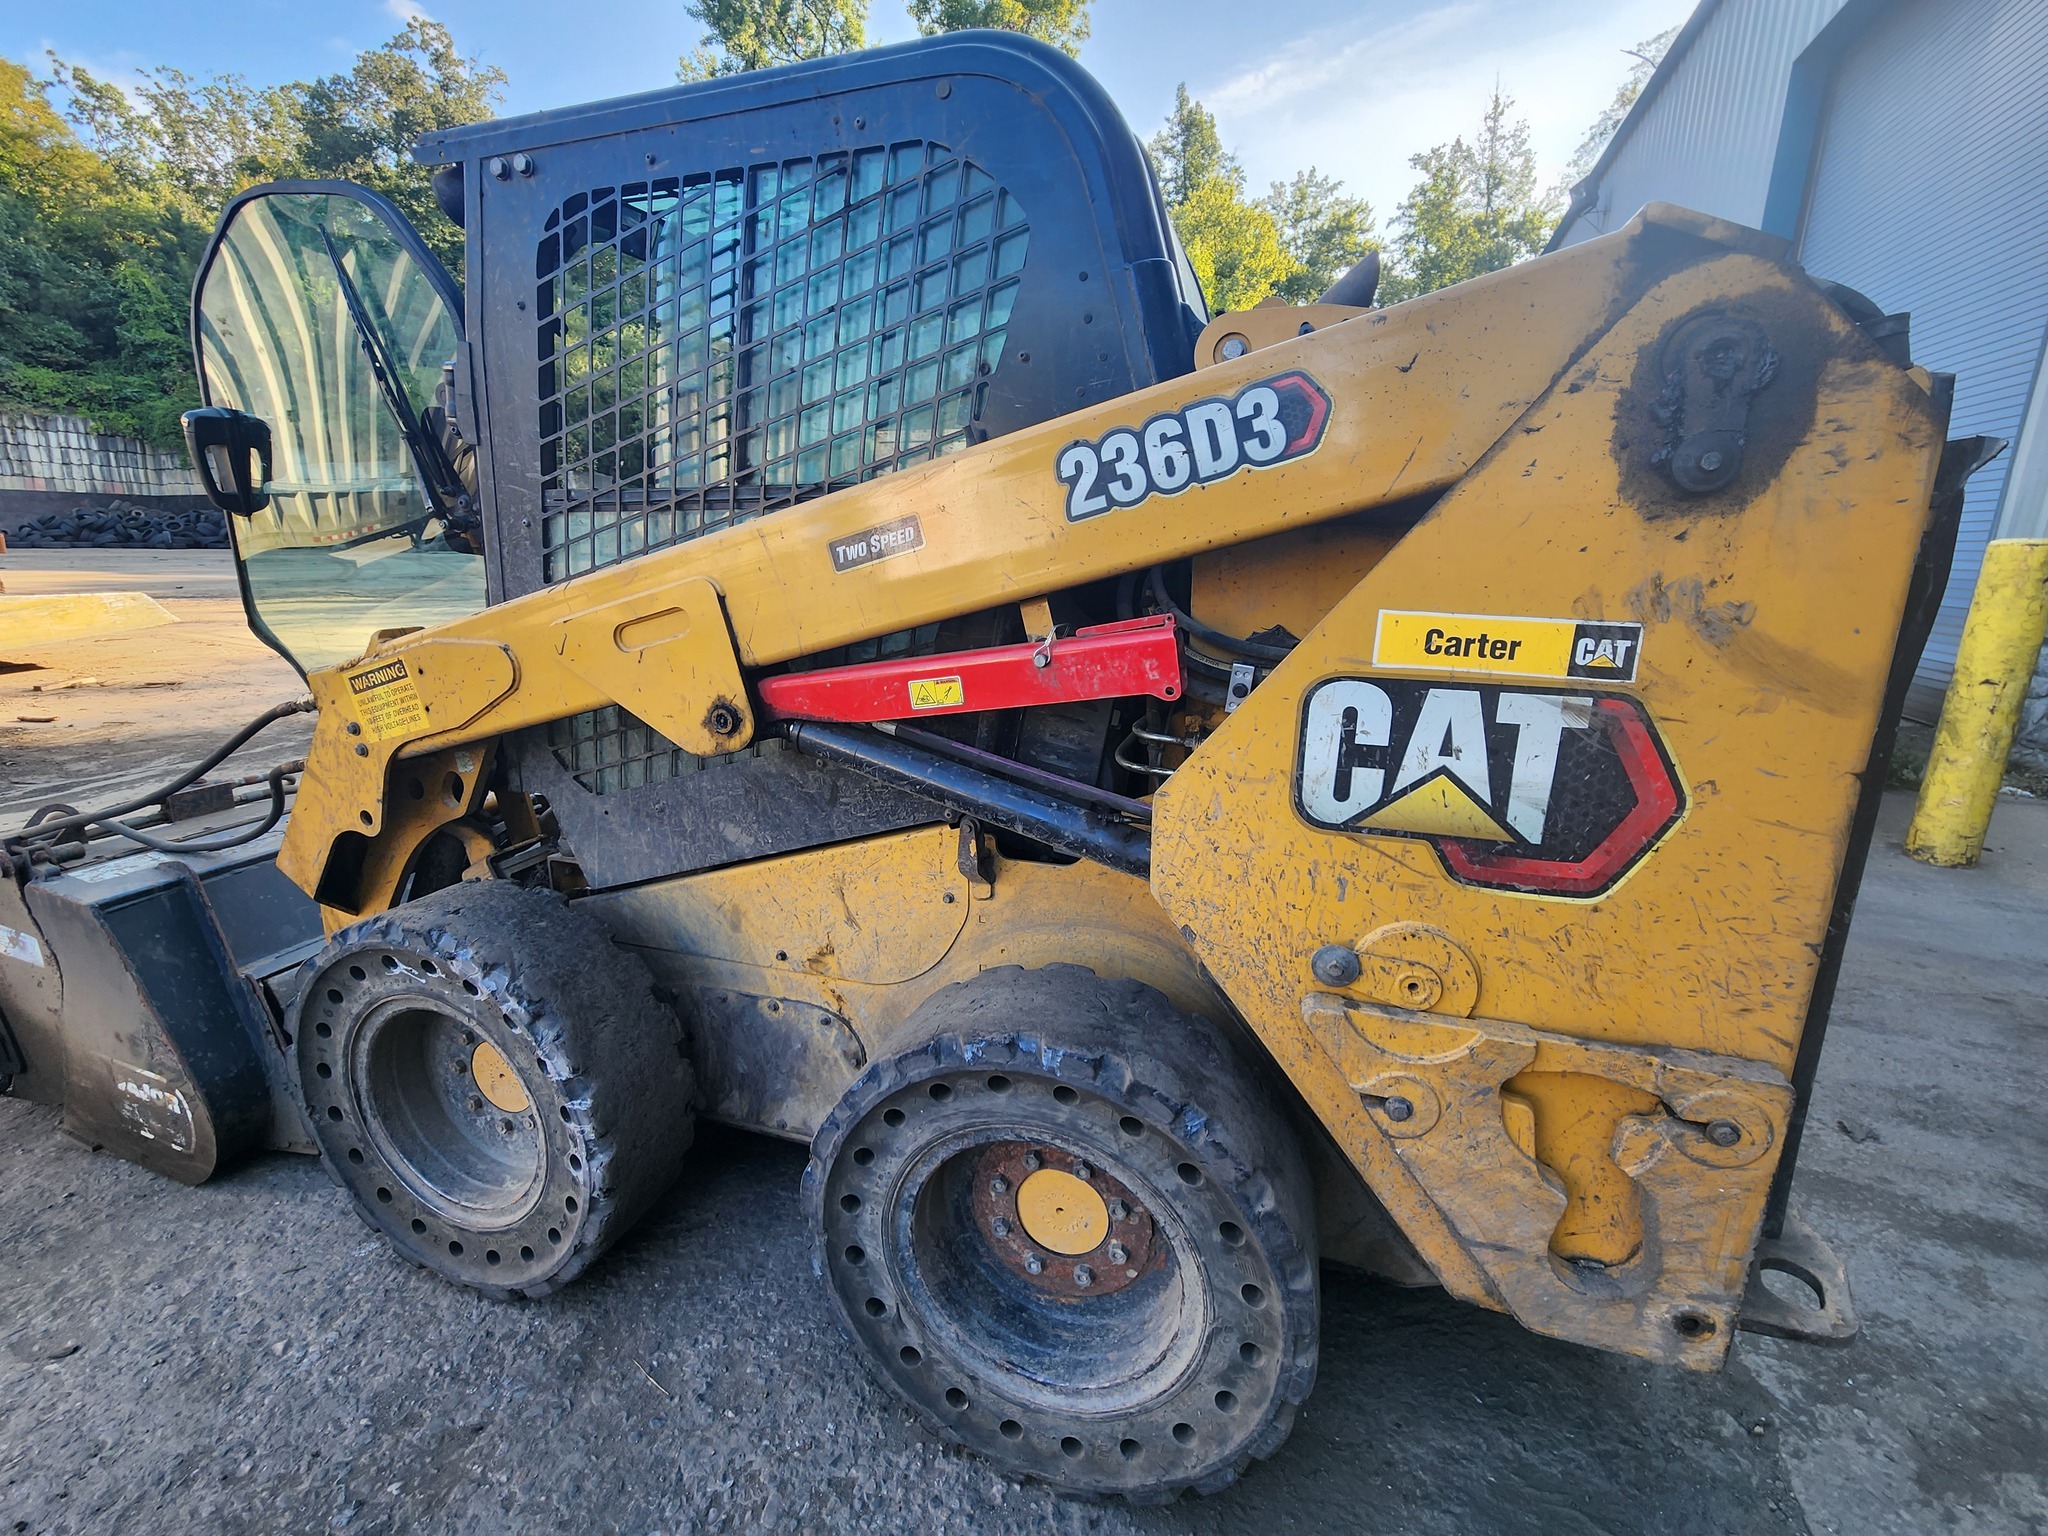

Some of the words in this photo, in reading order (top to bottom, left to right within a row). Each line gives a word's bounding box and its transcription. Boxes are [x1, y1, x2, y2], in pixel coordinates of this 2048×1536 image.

[1060, 386, 1288, 517] 236D3
[1424, 628, 1522, 661] Carter
[1575, 637, 1632, 669] CAT
[351, 664, 406, 691] WARNING
[357, 693, 385, 707] UNLAWFUL
[384, 690, 392, 699] TO
[391, 683, 414, 696] OPERATE
[360, 707, 372, 717] THIS
[371, 698, 400, 714] EQUIPMENT
[399, 692, 419, 705] WITHIN
[372, 714, 385, 723] FEET
[385, 711, 392, 720] OF
[392, 703, 420, 717] OVERHEAD
[385, 718, 407, 730] VOLTAGE
[407, 714, 421, 724] LINES
[1301, 680, 1594, 845] CAT
